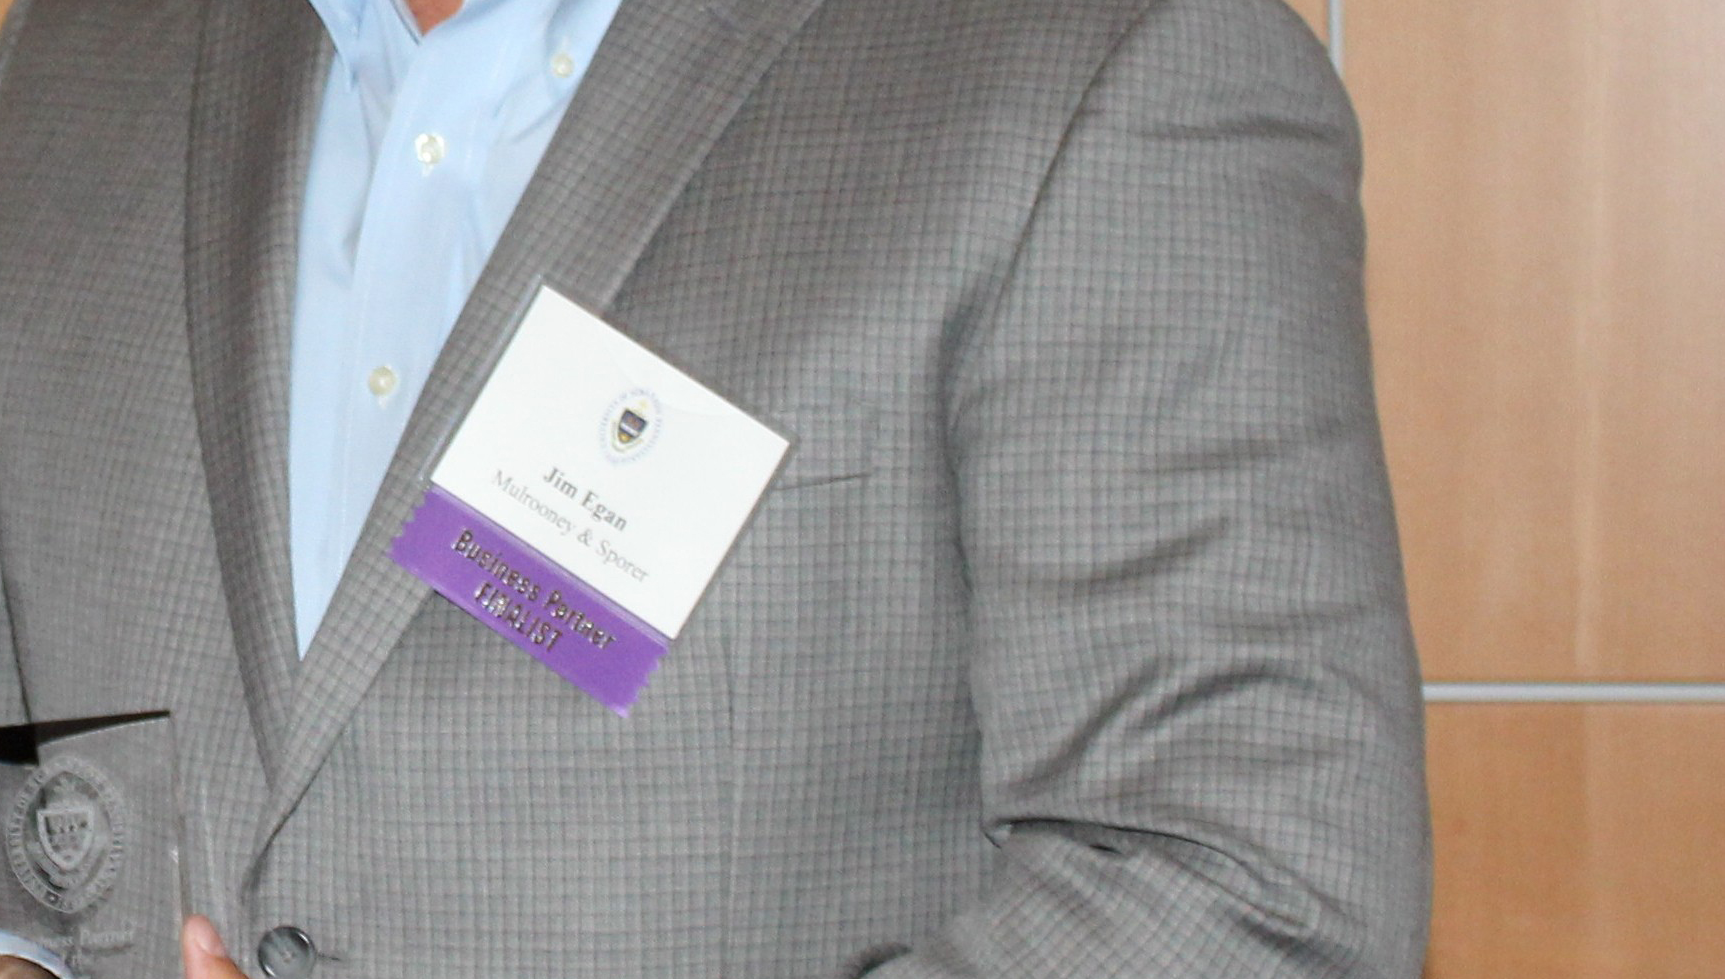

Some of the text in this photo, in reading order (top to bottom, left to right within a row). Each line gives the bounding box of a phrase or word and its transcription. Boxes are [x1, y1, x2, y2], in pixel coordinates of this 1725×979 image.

[492, 470, 650, 583] Mulrooney & Sporer
[543, 467, 628, 533] Jim Egan
[453, 529, 617, 650] Business Partner
[474, 581, 563, 653] FINALIST
